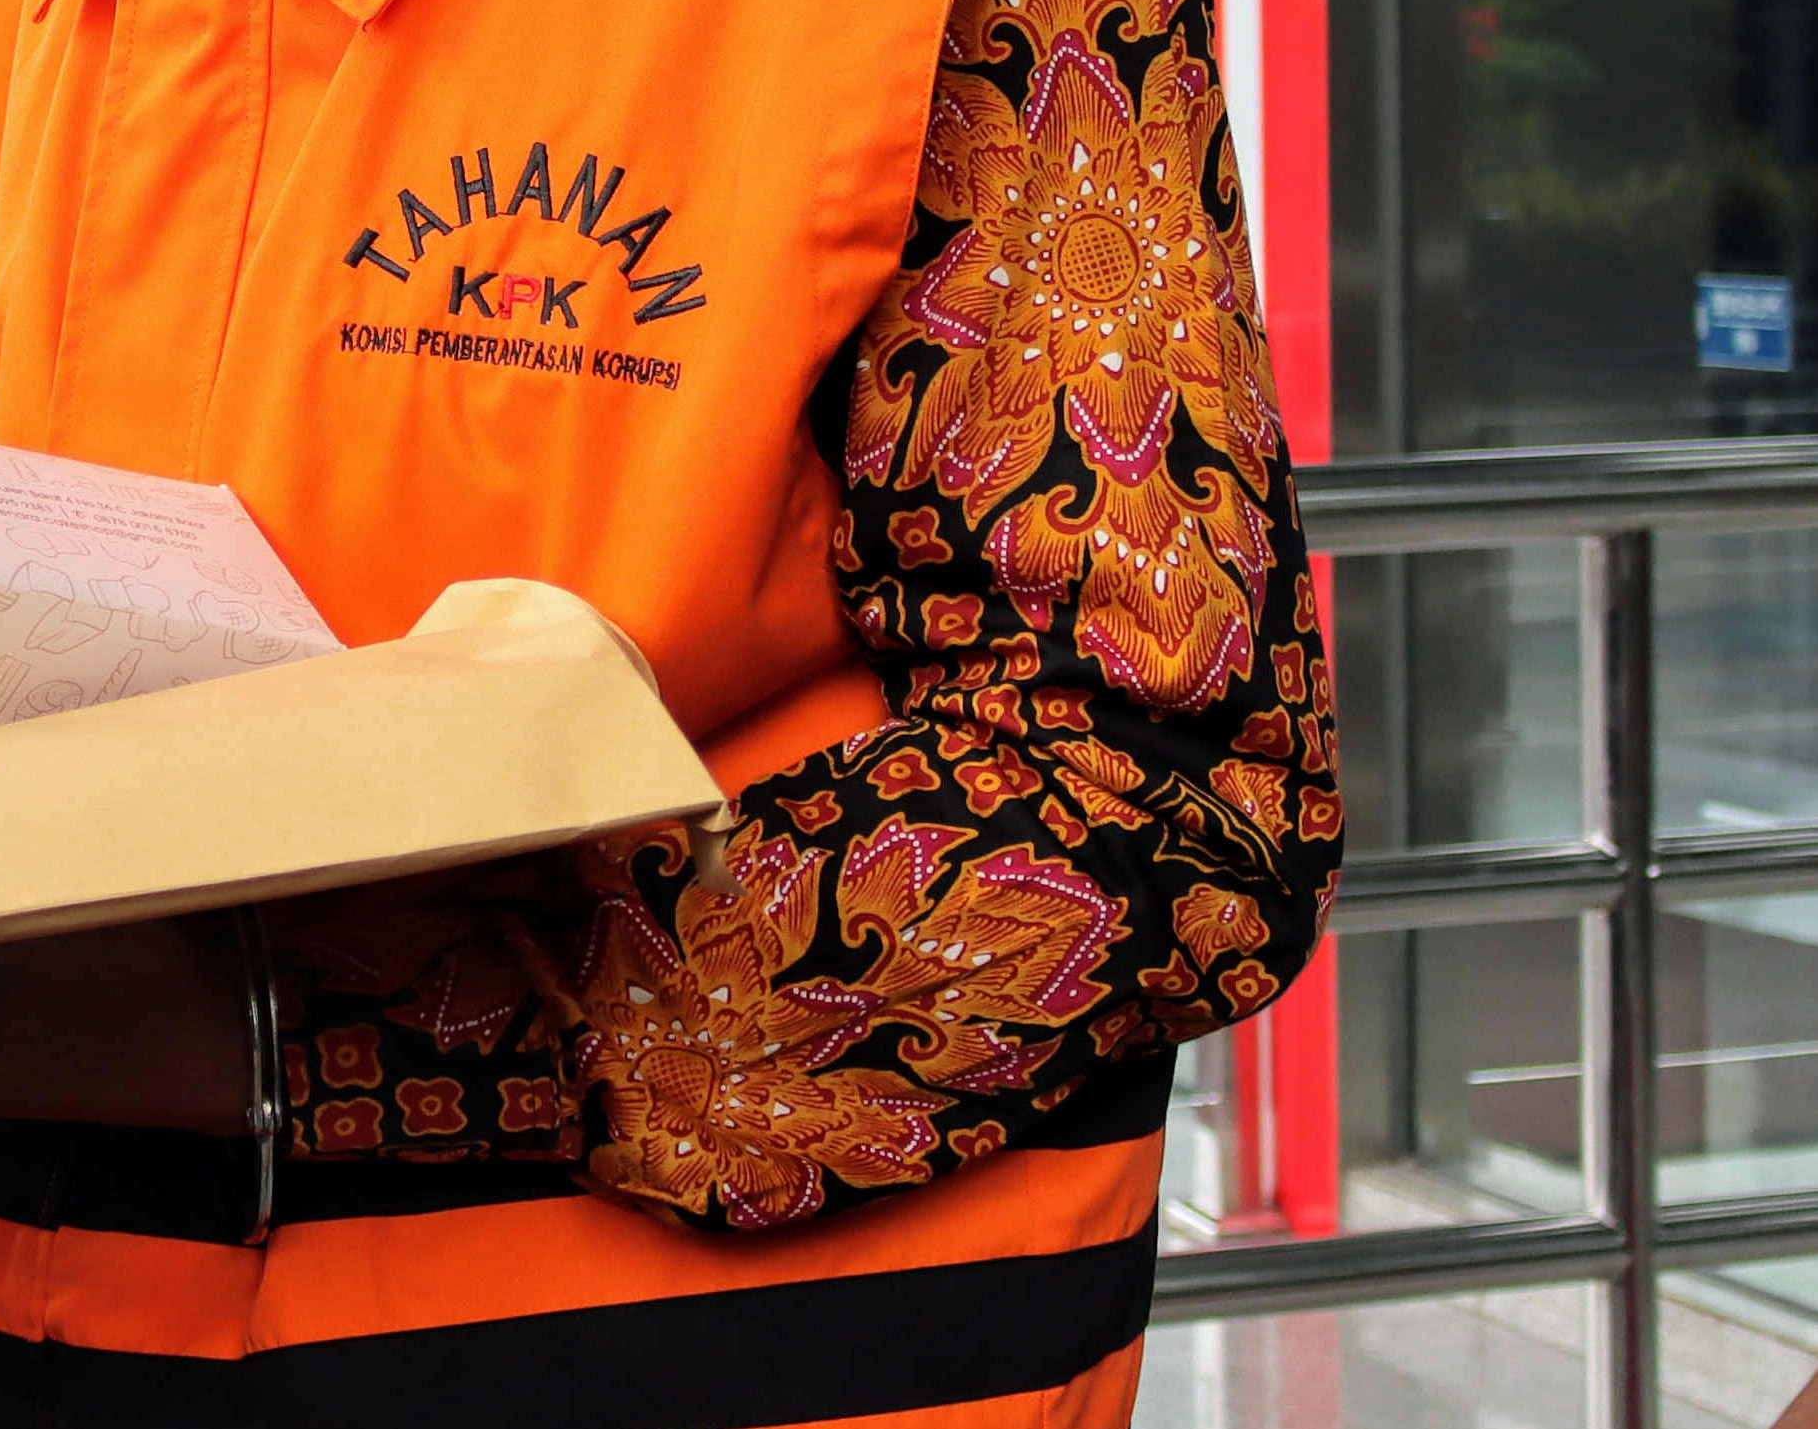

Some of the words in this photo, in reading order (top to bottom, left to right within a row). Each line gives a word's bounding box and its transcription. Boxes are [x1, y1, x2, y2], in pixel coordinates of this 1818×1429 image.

[342, 141, 707, 325] TAHANAN
[448, 266, 587, 329] KPK
[340, 323, 407, 355] KOMISI
[415, 328, 583, 376] PEMBERANTASAN
[592, 349, 681, 391] KORUPSI
